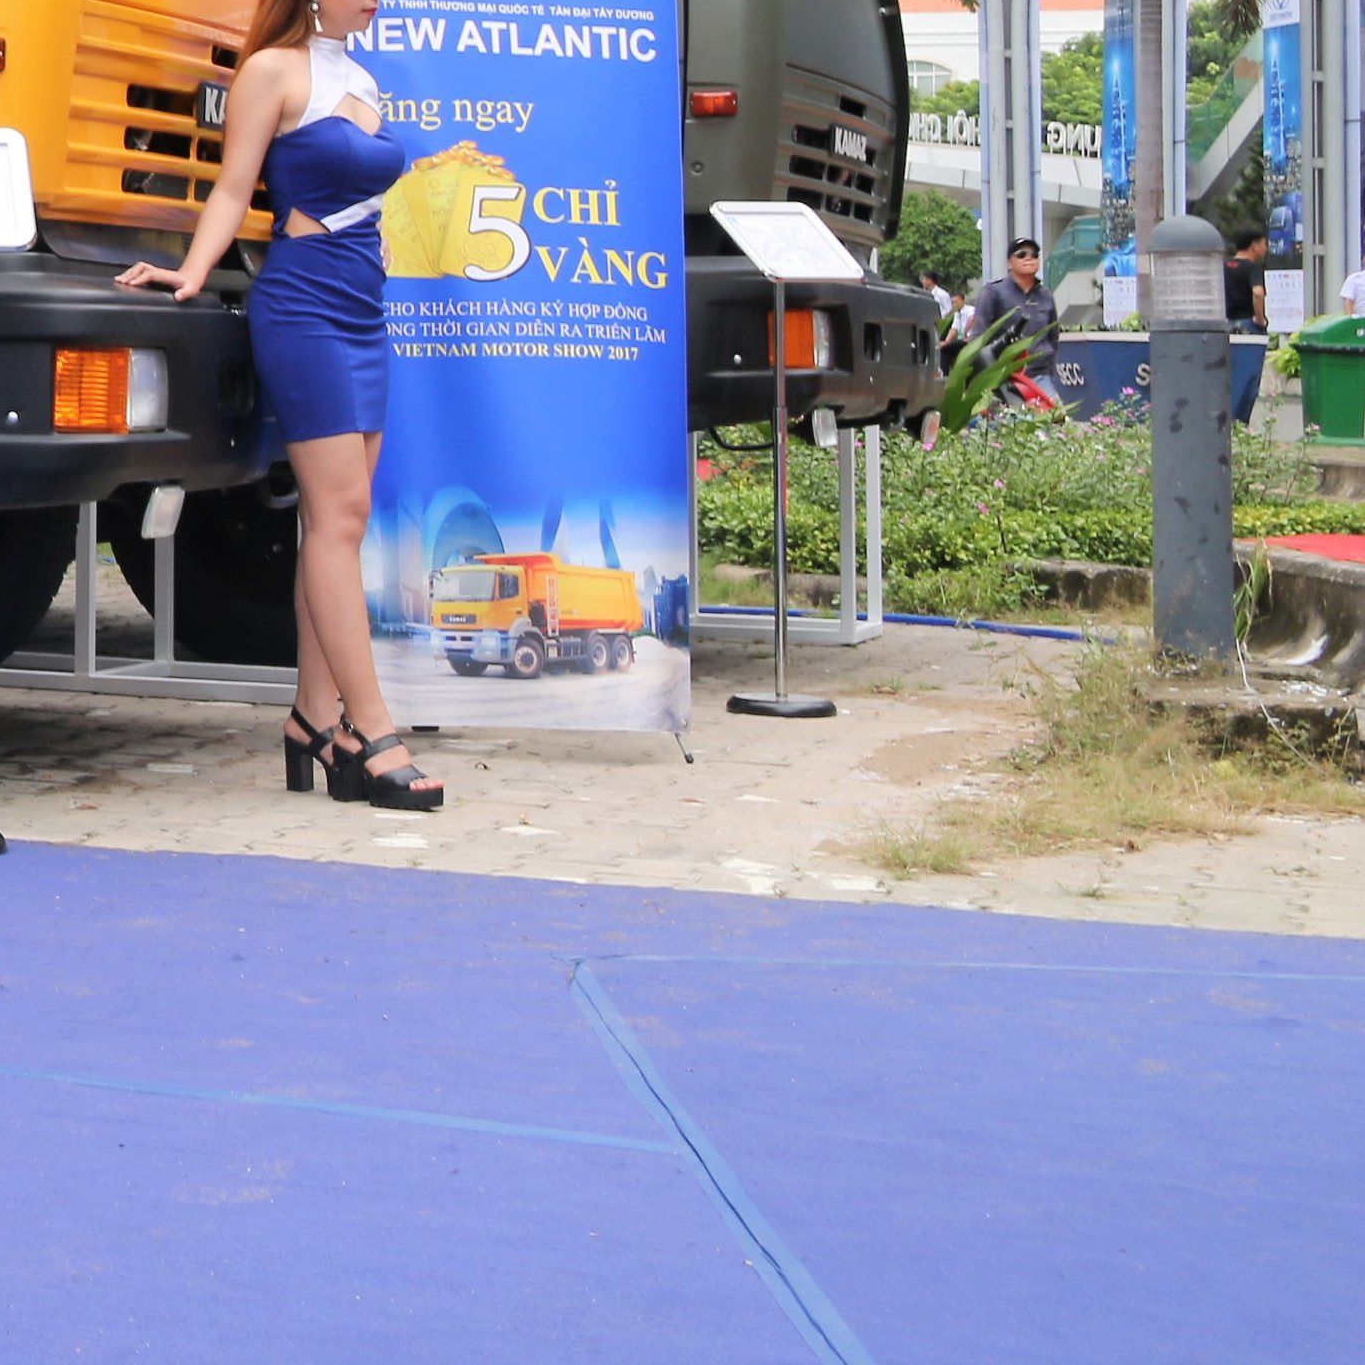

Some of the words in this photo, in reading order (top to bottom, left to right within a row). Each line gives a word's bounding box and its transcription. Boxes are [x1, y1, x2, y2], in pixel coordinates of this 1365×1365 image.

[382, 0, 396, 9] TY
[399, 0, 428, 10] TNHH
[347, 17, 446, 52] NEW
[456, 19, 656, 63] ATLANTIC
[379, 91, 441, 132] ăng
[453, 98, 535, 133] ngay
[834, 126, 867, 162] KAMAZ
[463, 184, 530, 282] 5
[532, 180, 620, 227] CHỈ
[535, 238, 668, 289] VÀNG
[419, 298, 481, 317] KHÁCH
[486, 297, 536, 317] HÀNG
[568, 302, 601, 320] HỢP
[420, 319, 462, 337] THỜI
[466, 321, 509, 337] GIAN
[560, 322, 582, 338] RA
[635, 325, 666, 343] LÃM
[393, 343, 477, 357] VIETNAM
[482, 342, 549, 357] MOTOR
[553, 343, 604, 359] SHOW
[608, 346, 638, 361] 2017
